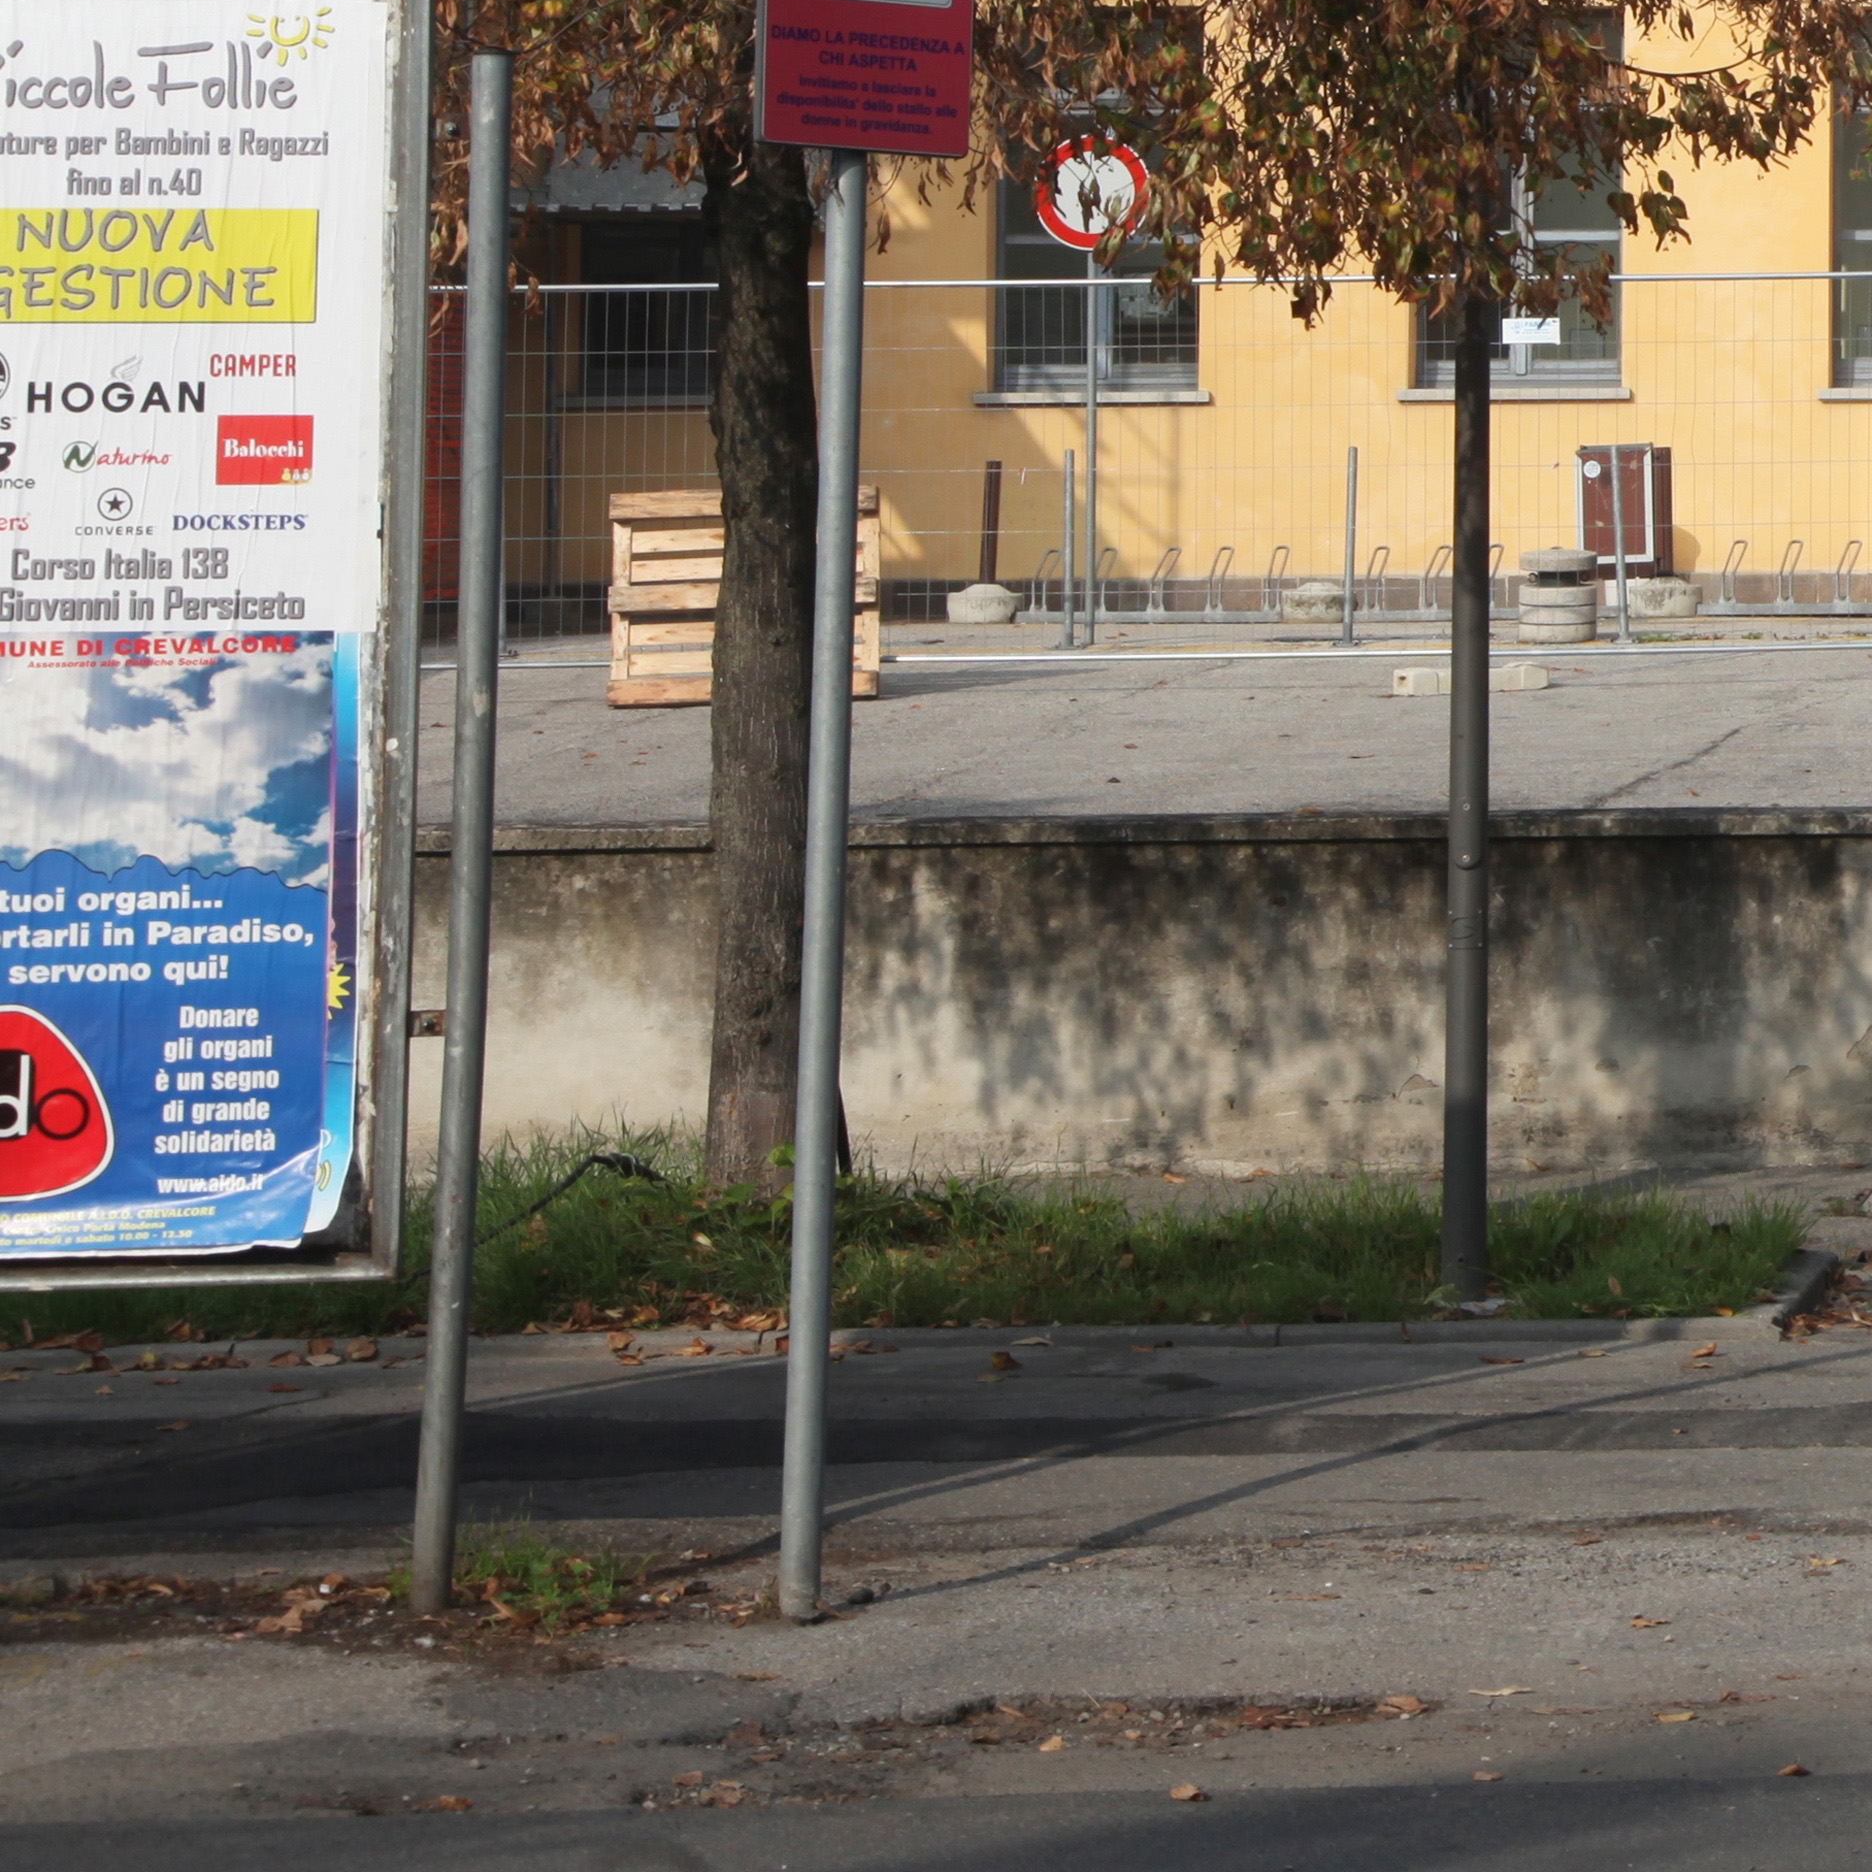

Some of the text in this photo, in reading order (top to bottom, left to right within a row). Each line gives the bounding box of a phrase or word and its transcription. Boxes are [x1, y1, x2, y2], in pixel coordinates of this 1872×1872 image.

[771, 25, 964, 55] DIAMO LA PRECEDENZA A
[819, 50, 917, 71] CHI ASPETTA
[0, 40, 297, 108] iccole Follie
[872, 79, 921, 95] lasciare
[801, 113, 841, 126] donne
[845, 115, 856, 127] in
[863, 99, 893, 112] dello
[935, 105, 957, 117] alle
[65, 132, 107, 160] per
[115, 128, 210, 155] Bambini
[218, 136, 231, 156] e
[239, 128, 329, 161] Ragazzi
[66, 168, 202, 195] fino al n.40
[17, 208, 214, 252] NUOVA
[210, 354, 296, 377] CAMPER
[27, 381, 206, 413] HOGAN
[222, 438, 303, 458] Balocchi
[75, 526, 154, 536] CONVERSE
[172, 514, 307, 531] DOCKSTEPS
[12, 547, 228, 580] Corso Italia 138
[0, 586, 305, 621] Giovanni in Persiceto
[77, 639, 104, 656] DI
[114, 636, 297, 655] CREVALCORE
[28, 657, 218, 669] Assessorato alle Politiche Sociali
[0, 885, 224, 916] tuoi organi...
[0, 919, 314, 951] rtarli in Paradiso,
[8, 955, 229, 986] servono qui!
[180, 1005, 259, 1029] Donare
[164, 1035, 273, 1063] gli organi
[155, 1068, 279, 1093] è un segno
[162, 1097, 270, 1124] di grande
[154, 1129, 276, 1154] solidarietà
[157, 1174, 264, 1194] www.aido.it
[138, 1206, 216, 1219] CREVALCORE
[119, 1221, 166, 1231] Modena
[76, 1233, 115, 1244] sabato
